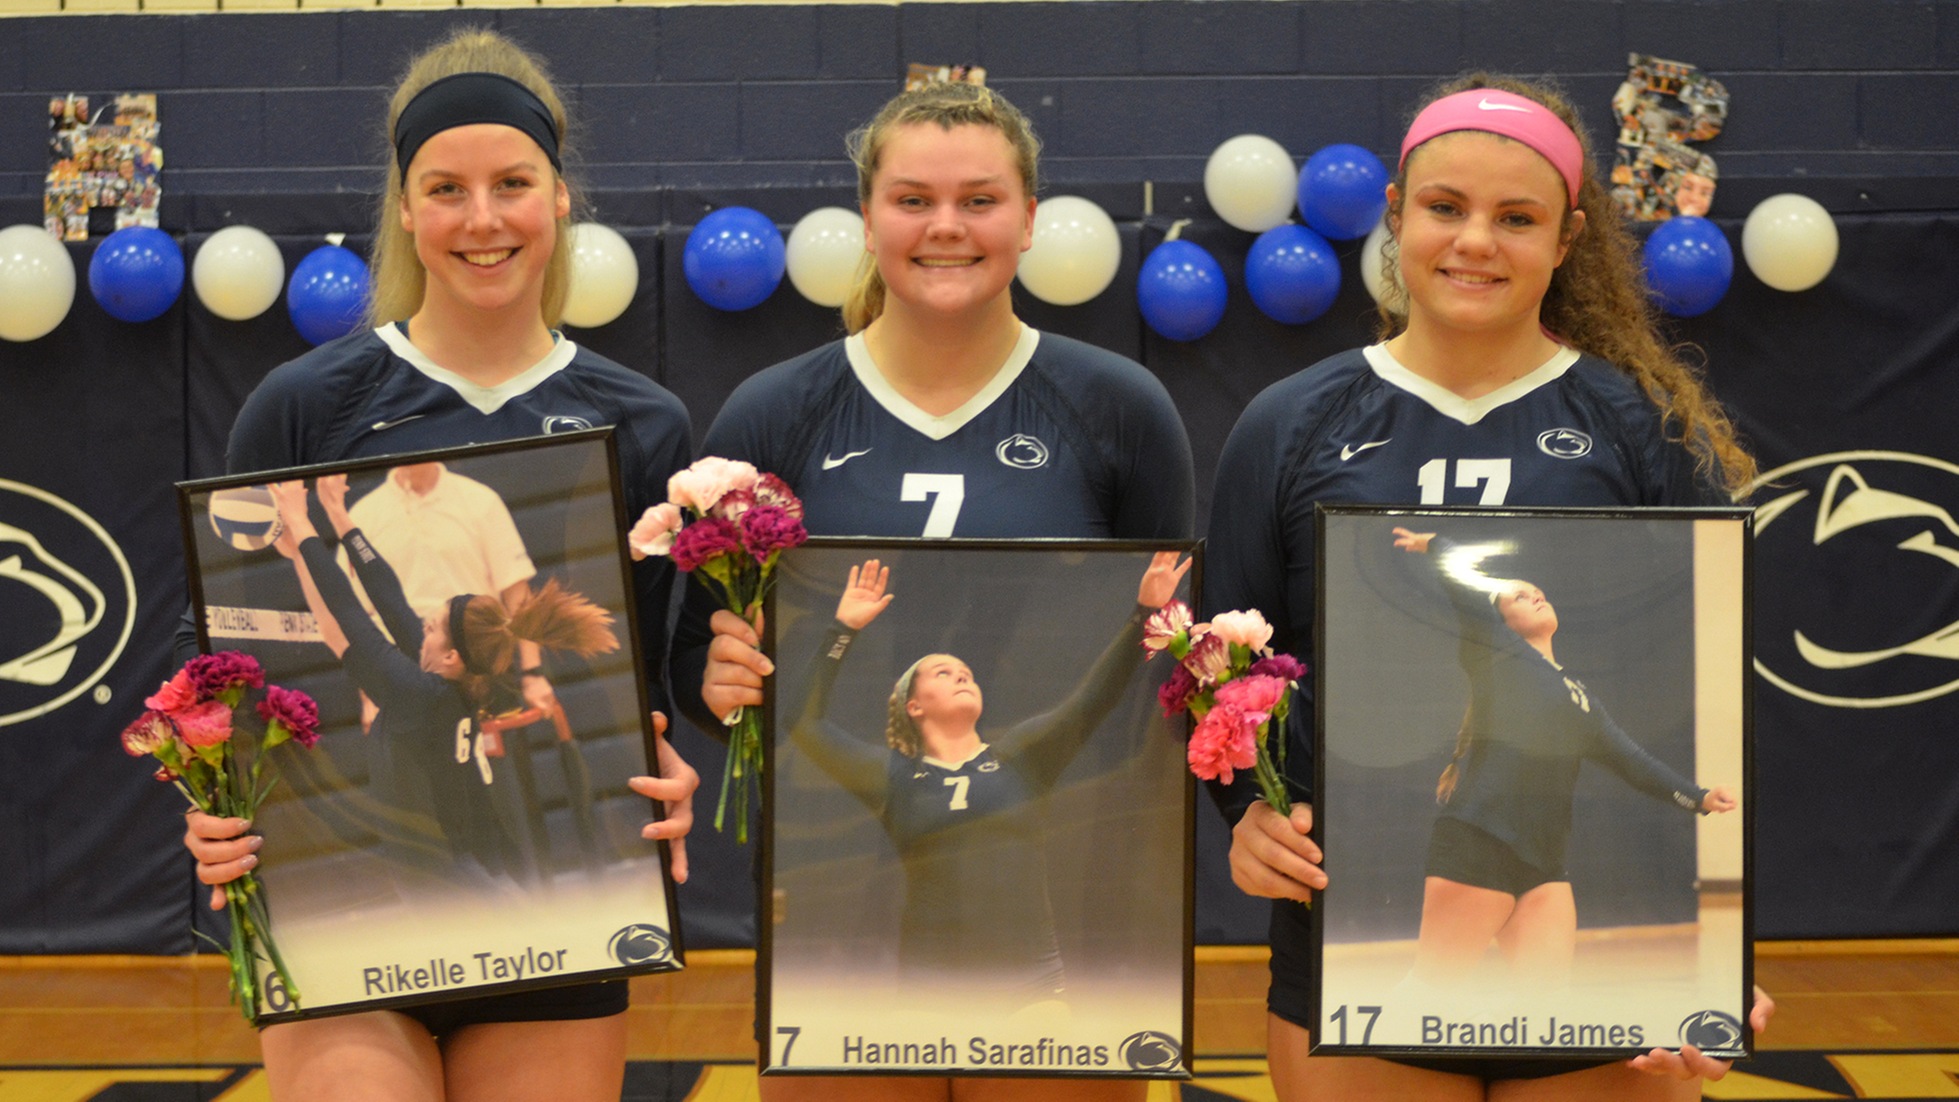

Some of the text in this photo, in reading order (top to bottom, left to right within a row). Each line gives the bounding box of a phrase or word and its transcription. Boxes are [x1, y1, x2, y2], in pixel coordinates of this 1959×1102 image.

[1417, 458, 1511, 505] 17
[901, 473, 965, 538] 7
[943, 775, 970, 811] 7
[265, 970, 290, 1012] 6
[363, 946, 568, 996] Rikelle Taylor
[1329, 1005, 1382, 1045] 17
[1421, 1015, 1645, 1046] Brandi James
[776, 1026, 801, 1066] 7
[842, 1035, 1109, 1067] Hannah Sarafinas
